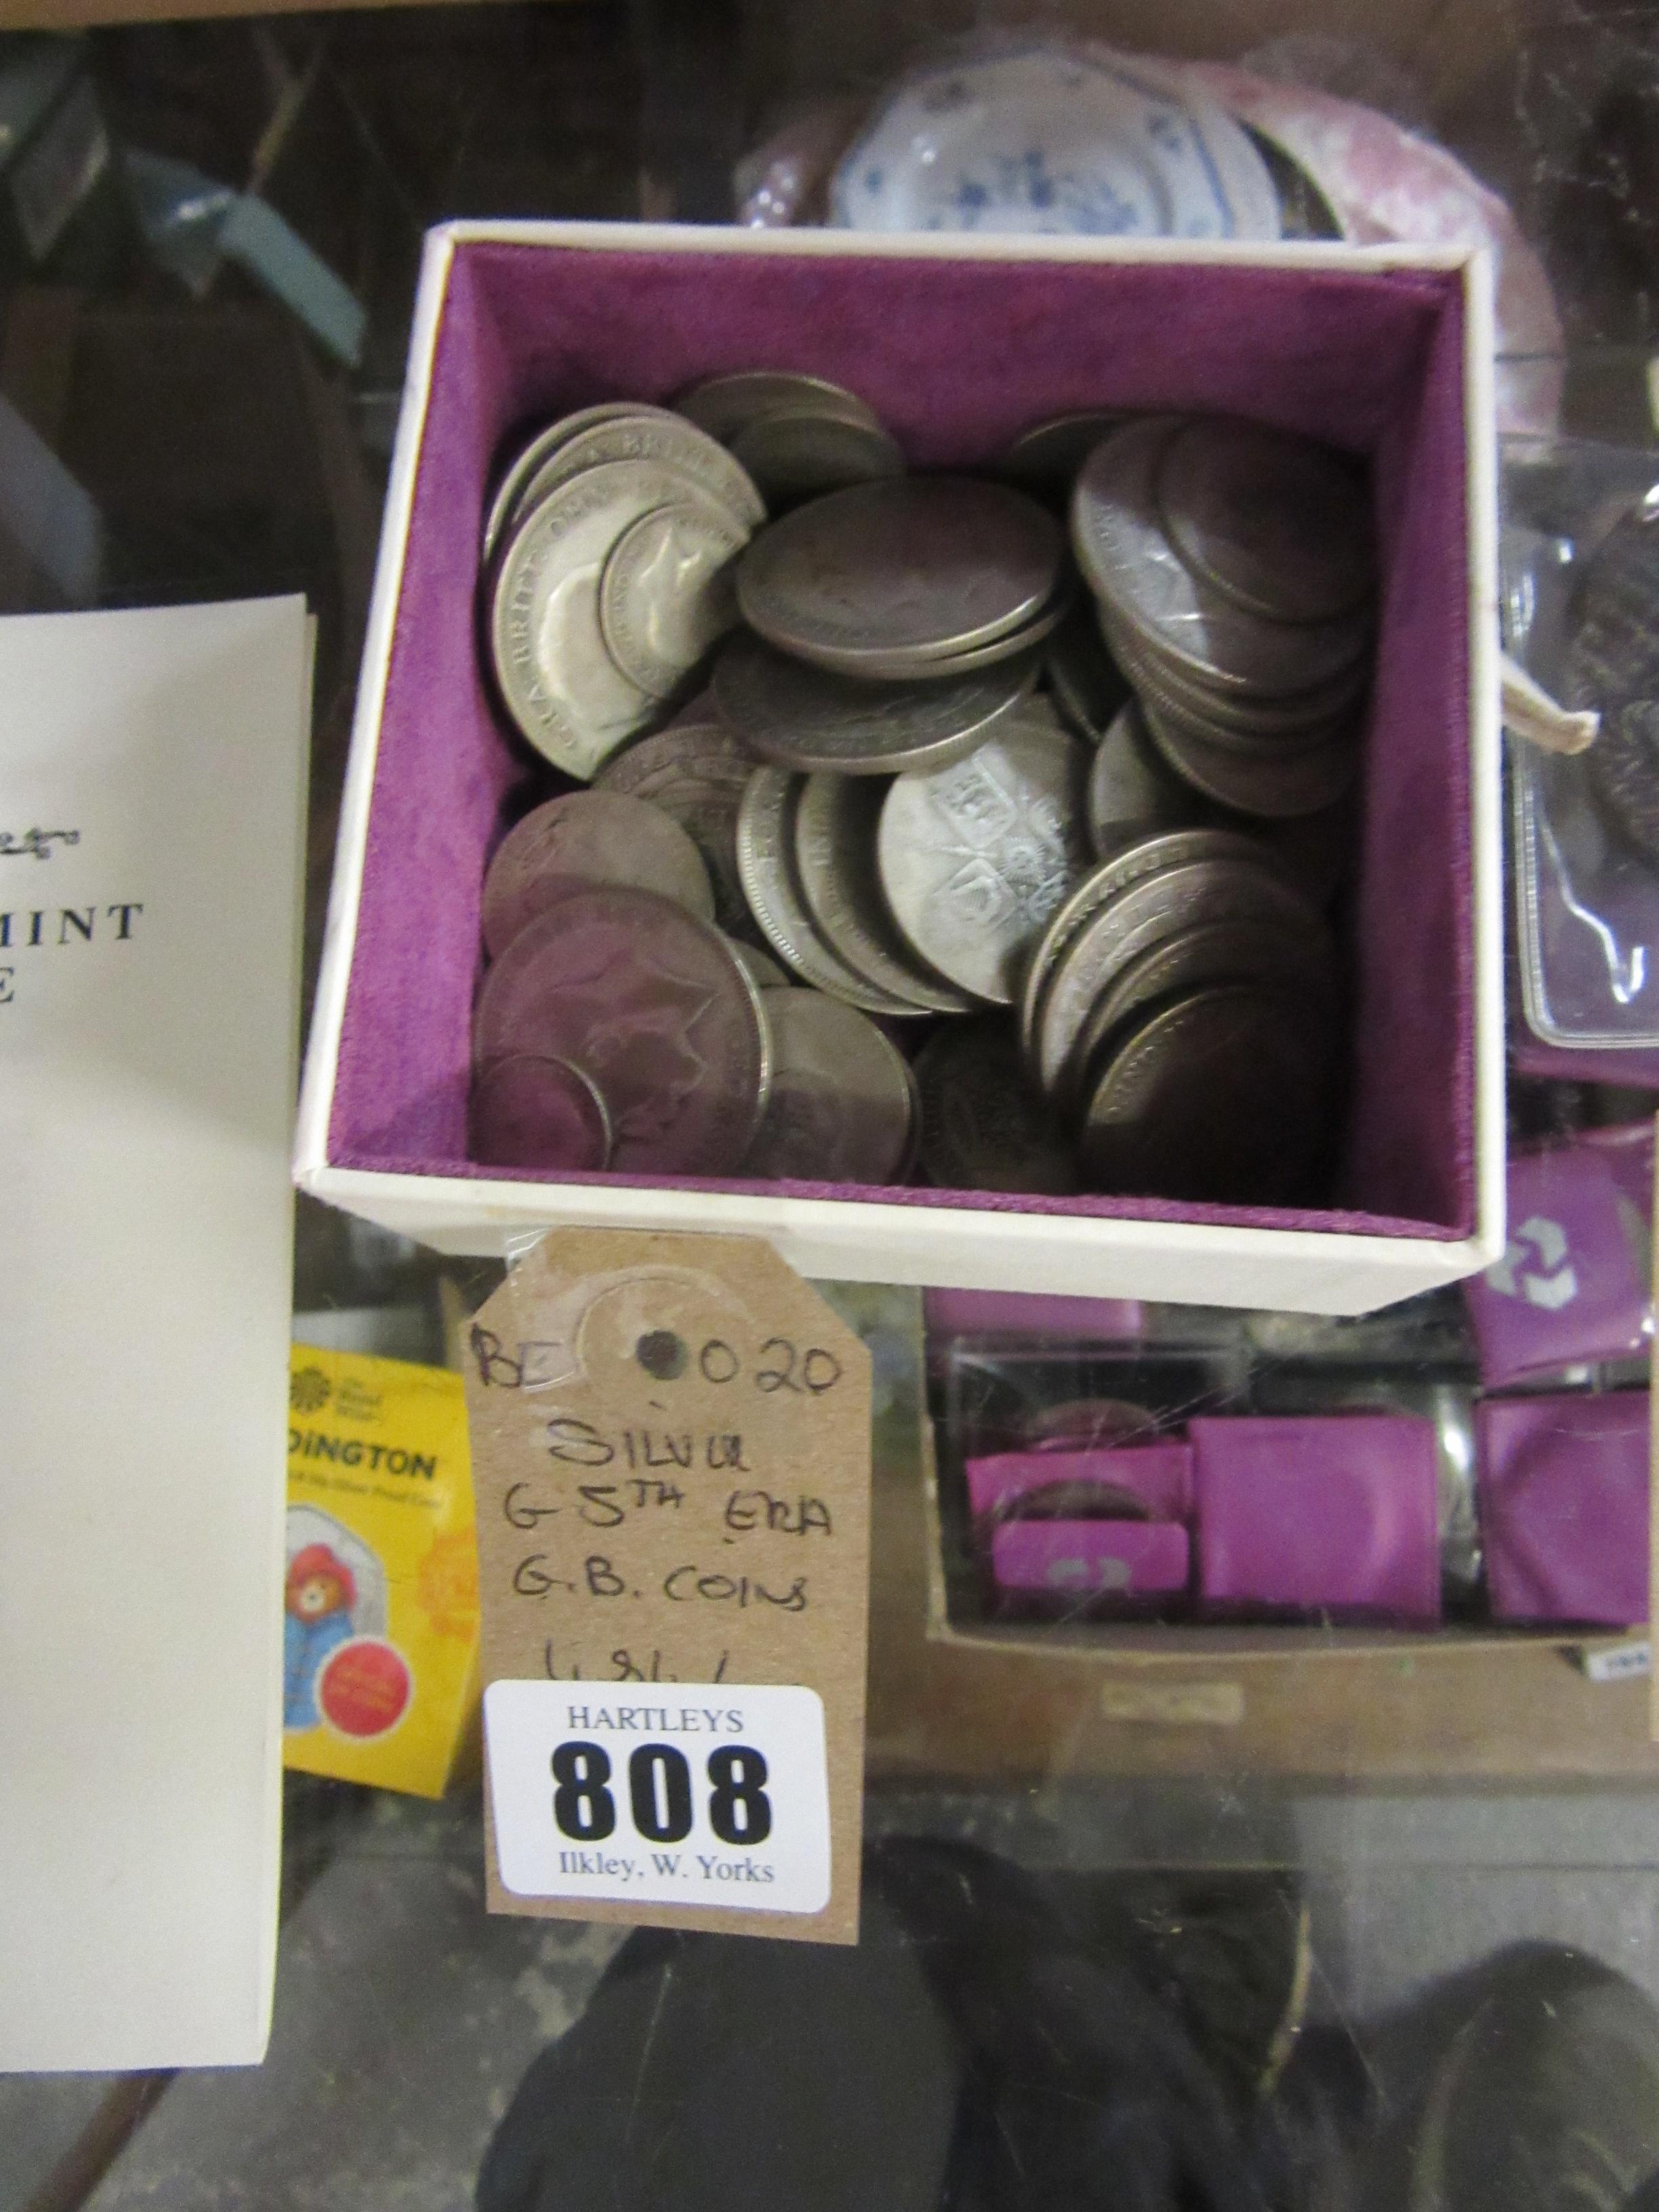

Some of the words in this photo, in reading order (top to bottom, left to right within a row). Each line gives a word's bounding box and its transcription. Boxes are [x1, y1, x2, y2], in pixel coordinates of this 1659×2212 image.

[724, 1490, 832, 1536] ERA
[663, 1564, 808, 1612] COINS
[567, 1706, 744, 1734] HARTLEYS
[550, 1740, 773, 1846] 808
[559, 1851, 644, 1881] Ilkley,
[651, 1854, 688, 1878] W.
[696, 1855, 775, 1883] Yorks
